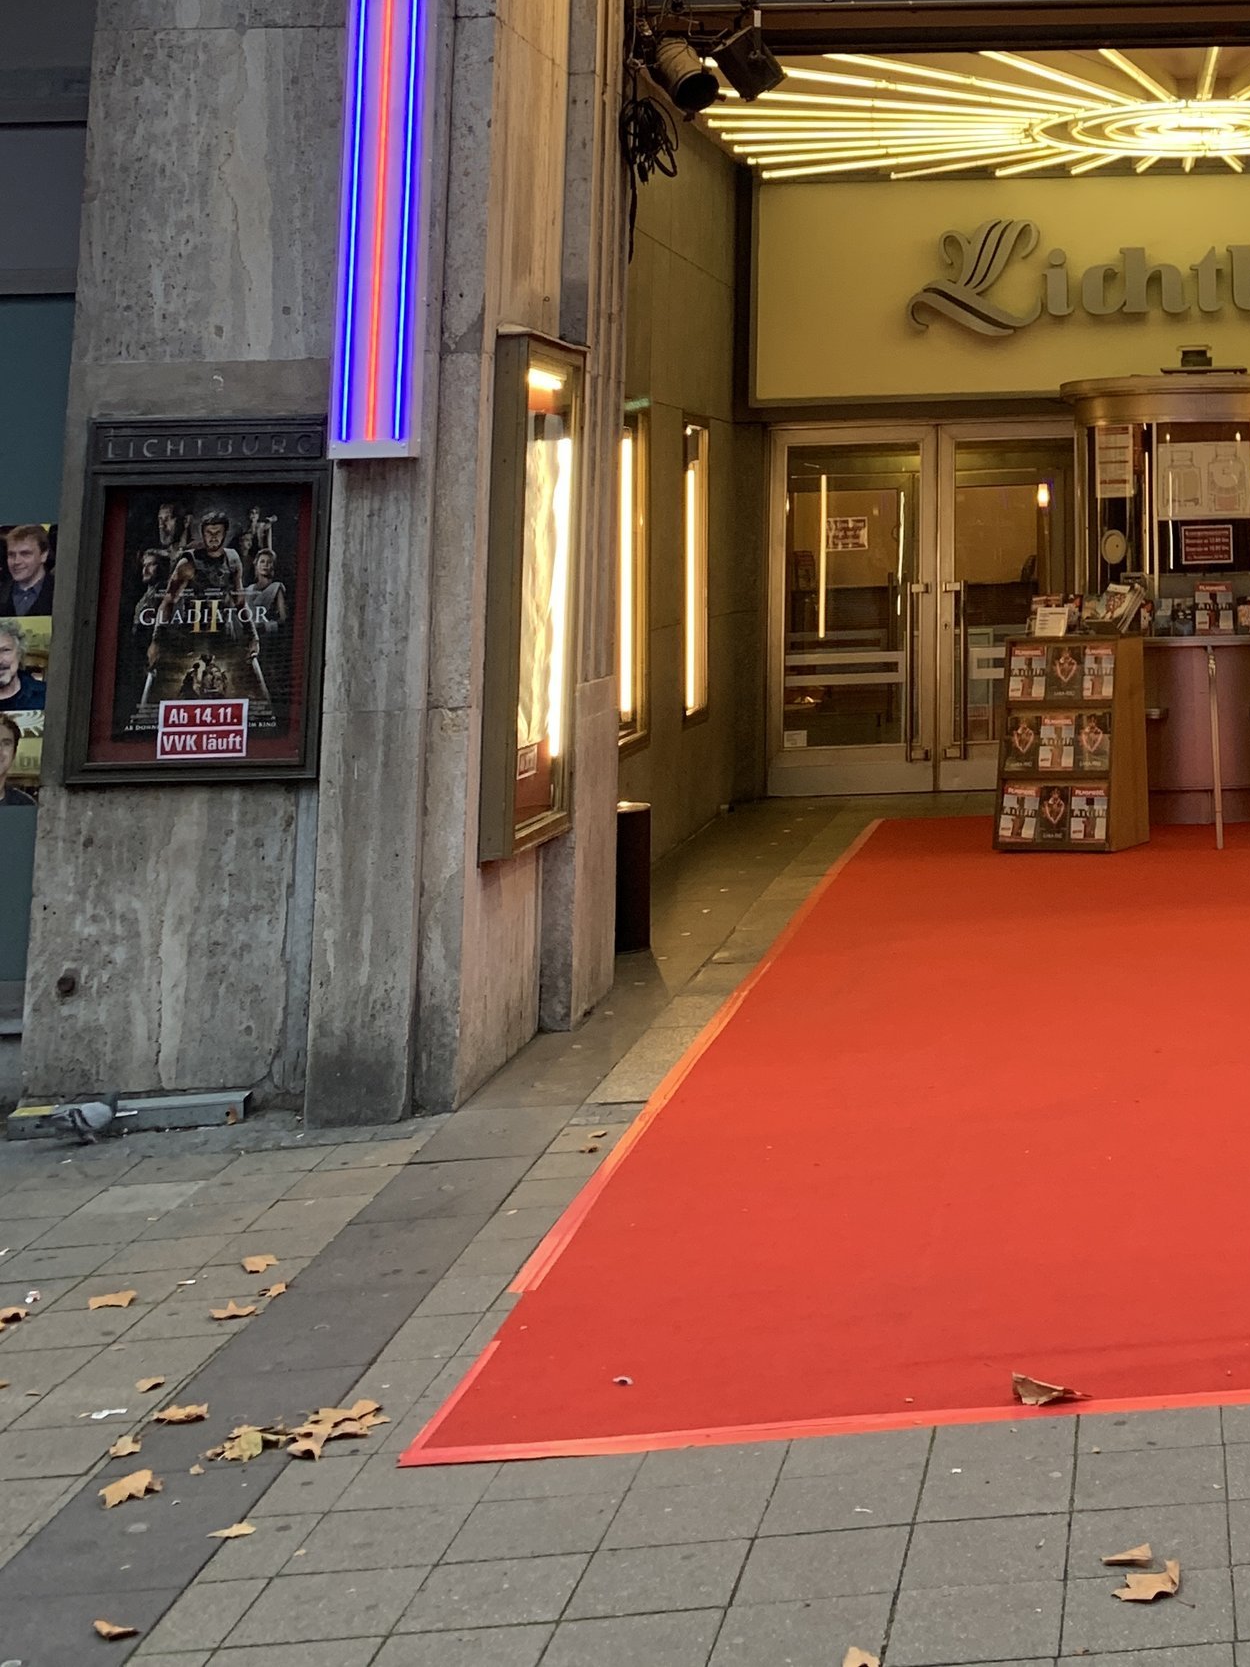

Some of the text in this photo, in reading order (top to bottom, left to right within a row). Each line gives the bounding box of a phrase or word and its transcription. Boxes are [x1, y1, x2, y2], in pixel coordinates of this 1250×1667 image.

[107, 435, 312, 458] LICHTBURG
[139, 606, 269, 626] GLADIATOR
[168, 707, 188, 725] Ab
[194, 706, 238, 724] 14.11.
[162, 733, 242, 752] VVK läuft
